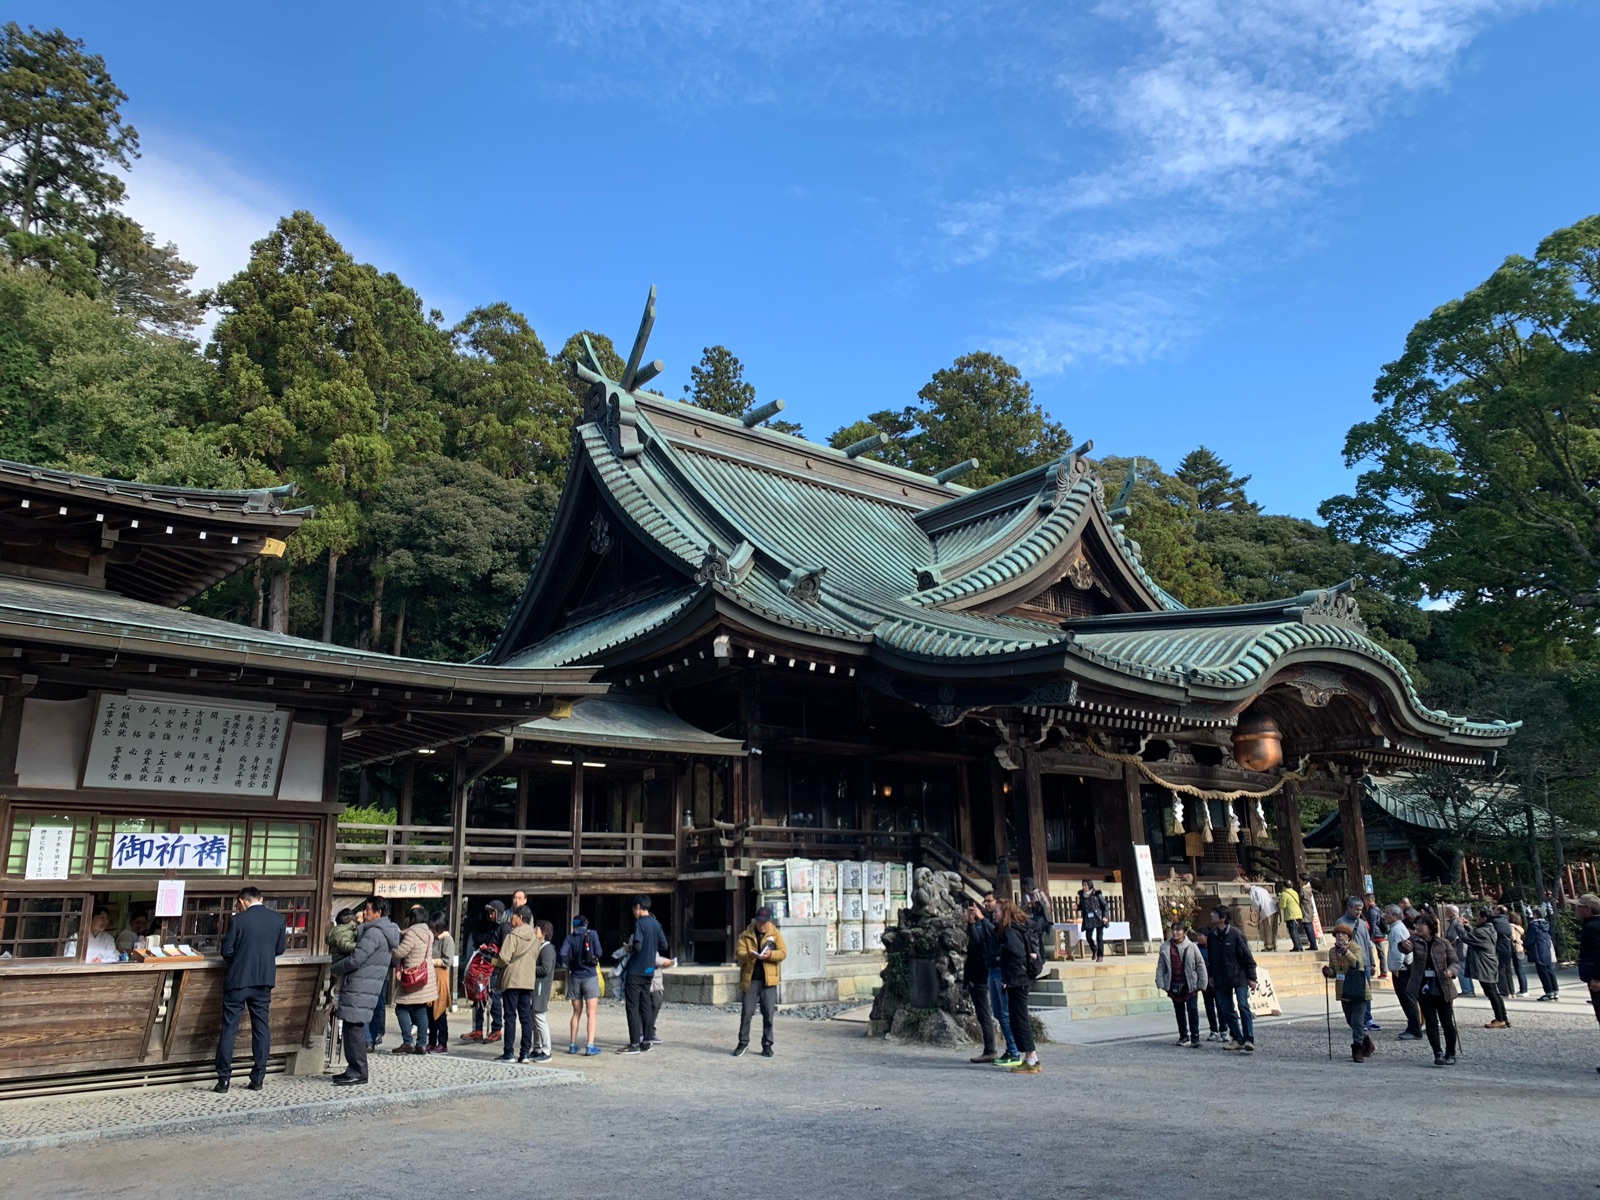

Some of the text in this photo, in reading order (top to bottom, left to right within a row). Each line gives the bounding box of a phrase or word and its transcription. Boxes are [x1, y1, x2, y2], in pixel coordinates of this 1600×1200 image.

[101, 702, 116, 736] 工事安全
[177, 708, 190, 741] 子授け
[191, 710, 205, 742] 方位除け
[256, 716, 267, 748] 交通安全
[269, 717, 281, 749] 家内安全
[107, 704, 132, 781] 心願成就 事業繁栄
[153, 707, 176, 783] 初宮詣 七五三詣
[138, 748, 153, 782] 学業成就
[113, 834, 227, 867] 御祈祷
[378, 882, 417, 893] 出世稲荷
